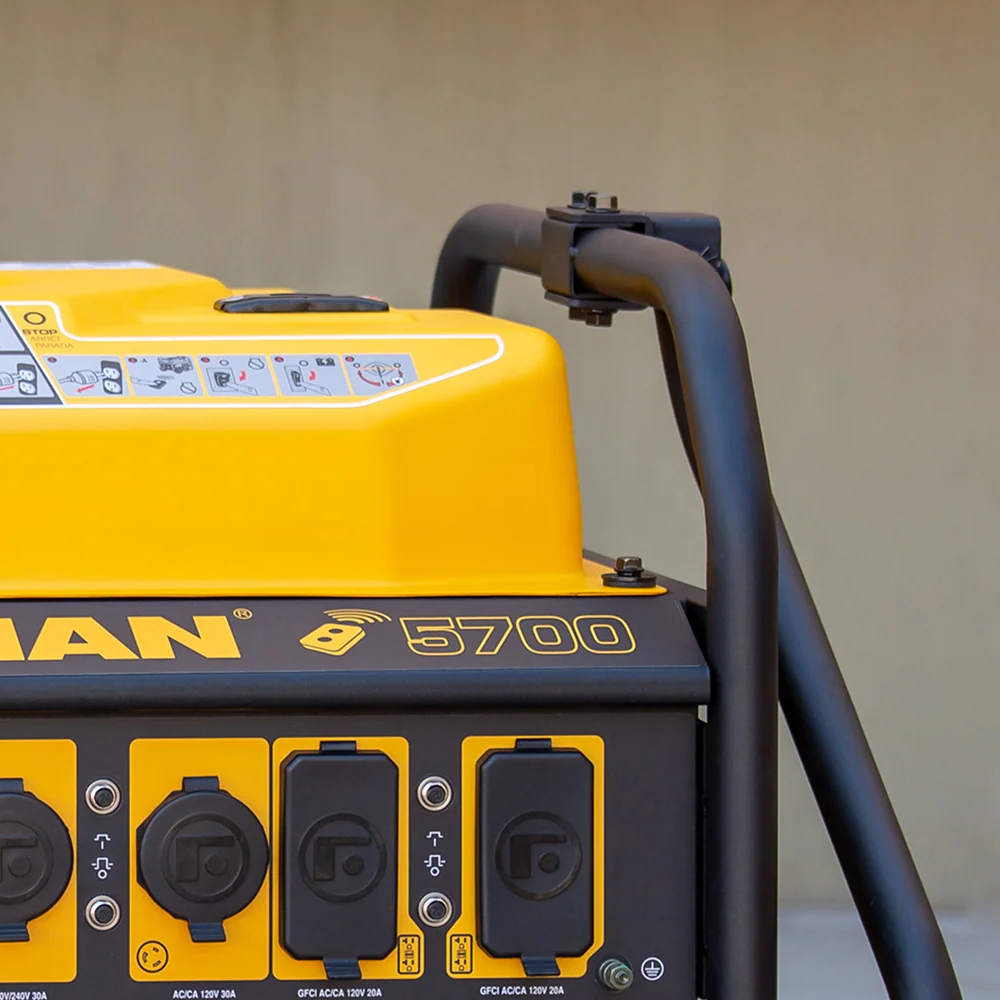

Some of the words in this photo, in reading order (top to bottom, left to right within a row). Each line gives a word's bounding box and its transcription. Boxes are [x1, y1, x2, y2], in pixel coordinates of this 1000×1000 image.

[400, 613, 638, 657] 5700
[31, 990, 48, 1000] 30A
[172, 989, 199, 999] AC/CA
[200, 989, 219, 999] 120V
[220, 989, 236, 999] 30A
[297, 989, 318, 999] GFCI
[319, 988, 345, 998] AC/CA
[346, 988, 365, 998] 120V
[366, 988, 382, 998] 20A
[480, 986, 500, 996] GFCI
[501, 986, 527, 996] AC/CA
[528, 986, 548, 995] 120V
[548, 985, 565, 995] 20A
